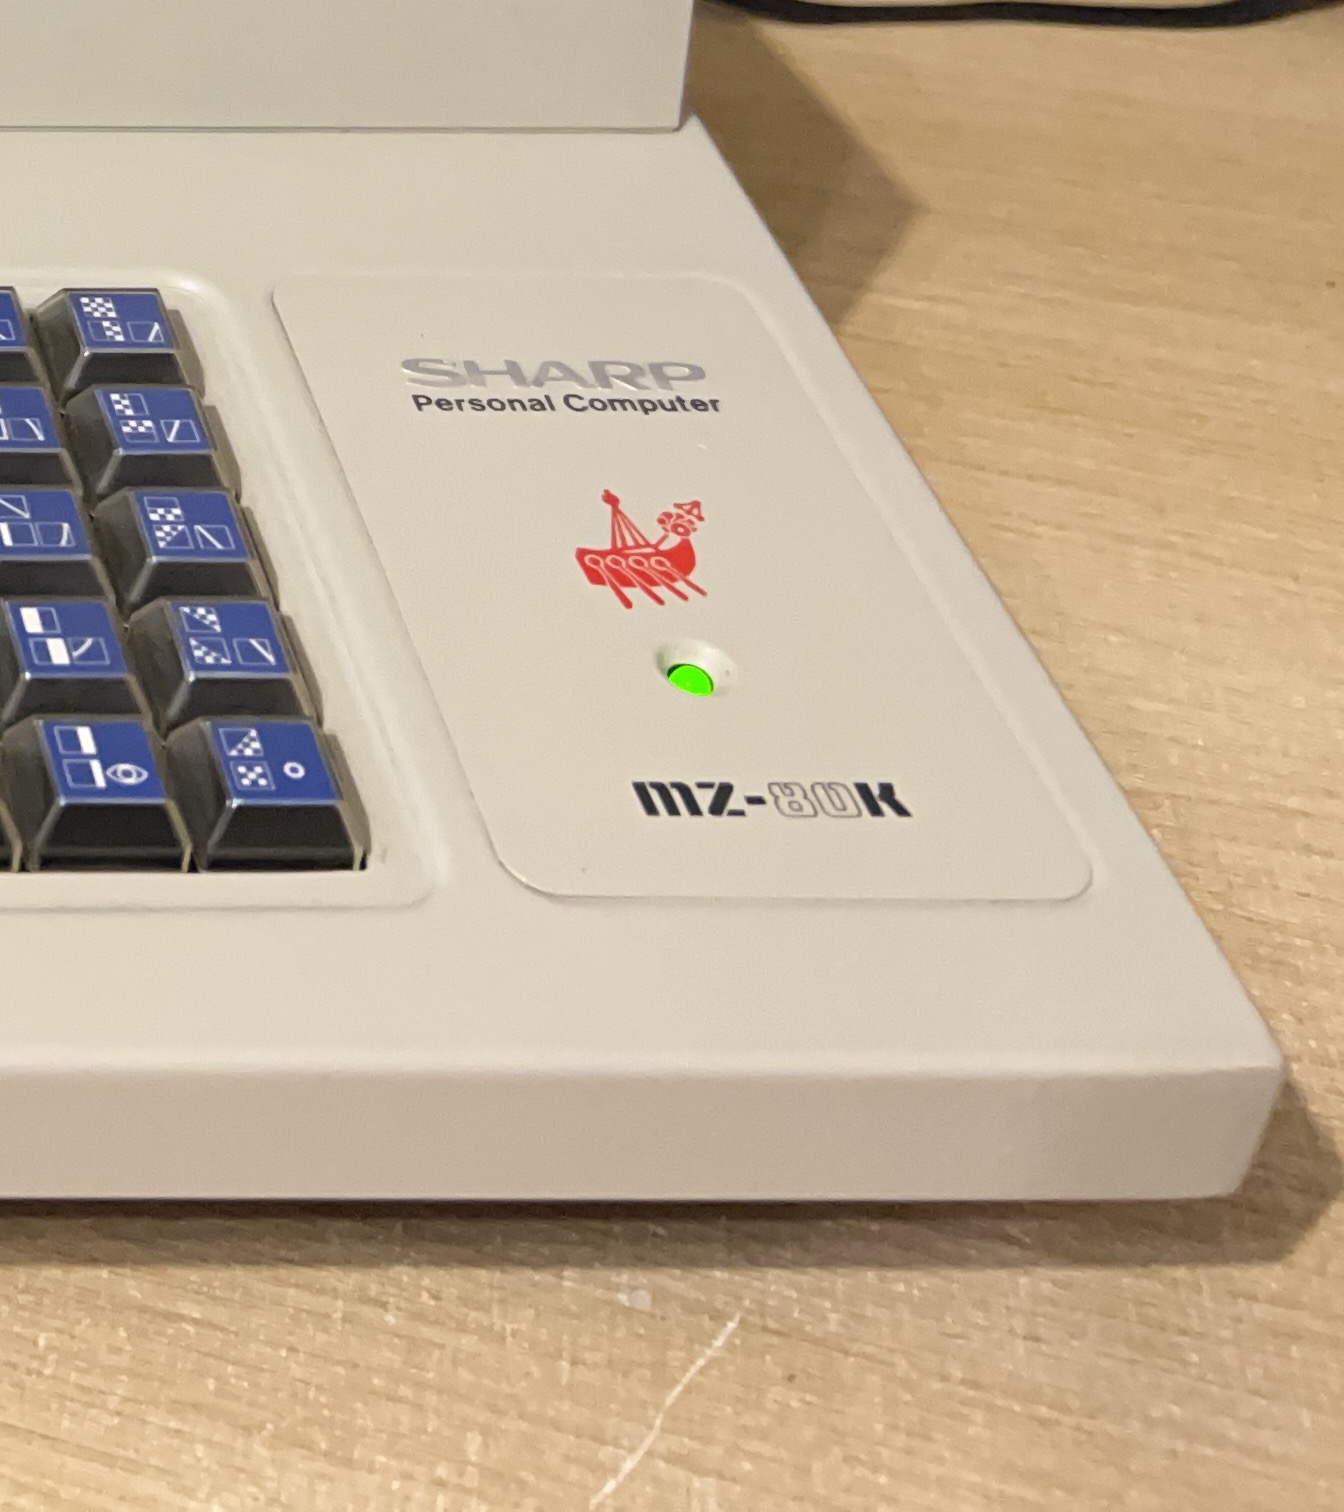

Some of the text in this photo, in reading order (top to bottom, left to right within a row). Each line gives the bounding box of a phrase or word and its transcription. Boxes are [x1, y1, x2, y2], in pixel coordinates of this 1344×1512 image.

[401, 357, 706, 390] SHARP
[411, 394, 720, 415] Personal Computer
